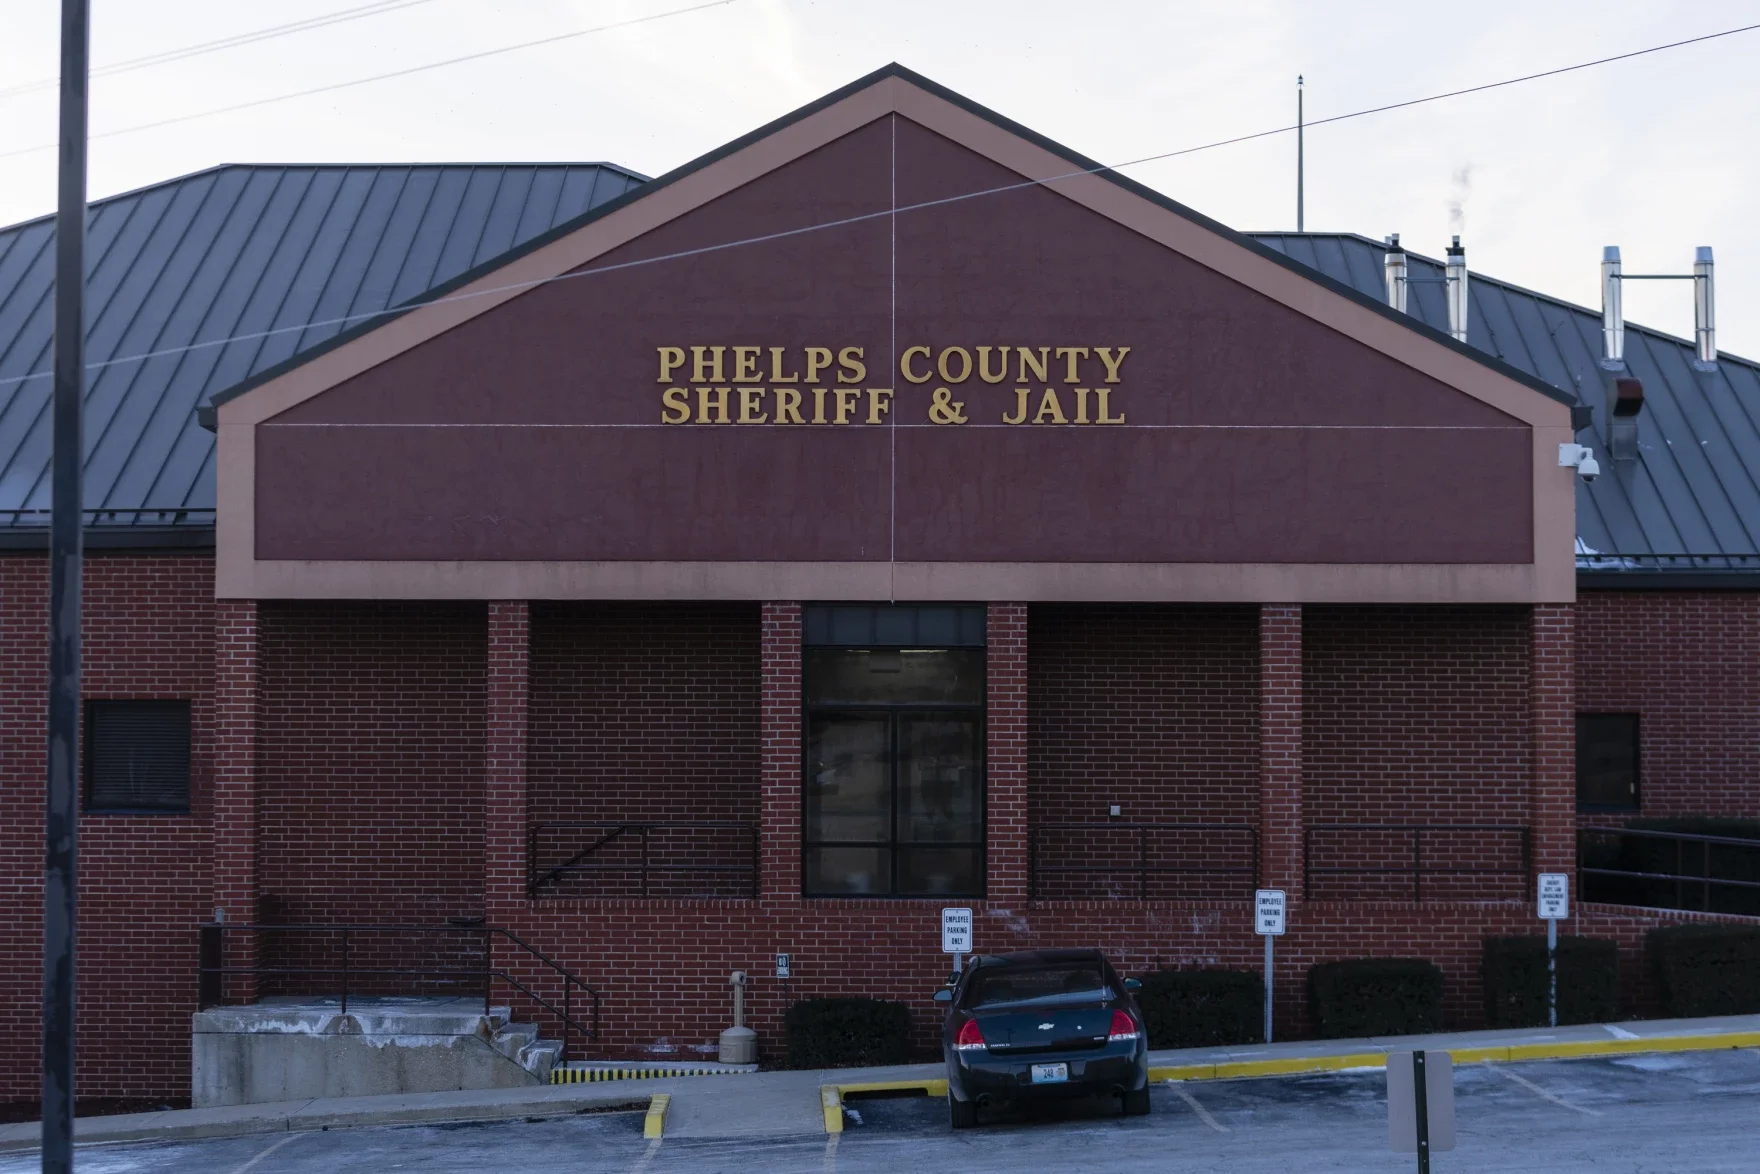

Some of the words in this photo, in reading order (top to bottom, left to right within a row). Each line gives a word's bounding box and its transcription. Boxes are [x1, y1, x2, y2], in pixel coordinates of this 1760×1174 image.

[656, 346, 867, 384] PHELPS
[900, 346, 1131, 384] COUNTY
[661, 387, 895, 425] SHERIFF
[928, 387, 969, 425] &
[1002, 388, 1126, 425] JAIL
[1258, 897, 1282, 905] EMPLOYEE
[1260, 908, 1281, 916] PARKING
[945, 915, 969, 923] EMPLOYEE
[1263, 919, 1276, 927] ONLY
[947, 926, 968, 934] PARKING
[951, 937, 963, 945] ONLY
